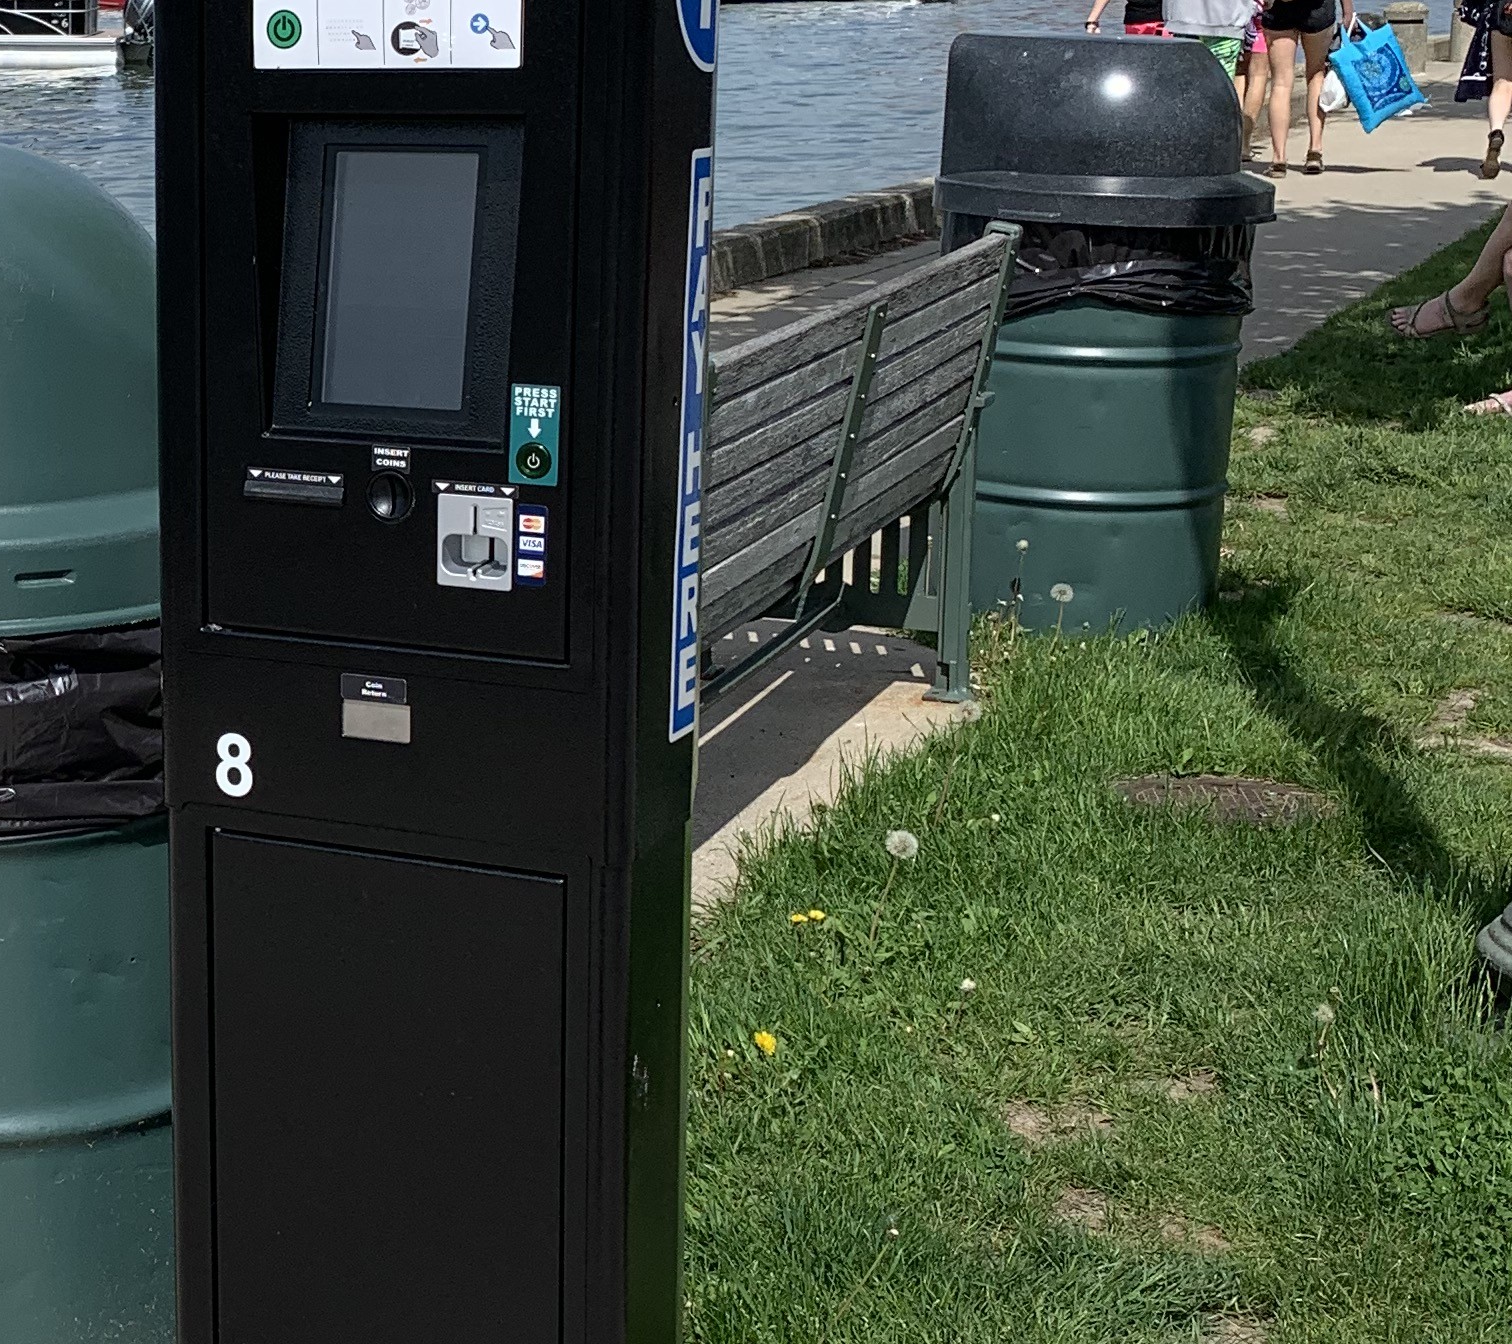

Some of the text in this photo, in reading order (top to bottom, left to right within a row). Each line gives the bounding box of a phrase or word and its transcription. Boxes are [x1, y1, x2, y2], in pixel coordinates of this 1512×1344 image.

[61, 17, 69, 28] 6
[514, 386, 558, 399] PRESS
[514, 396, 558, 408] START
[515, 406, 555, 418] FIRST
[373, 447, 410, 457] INSERT
[375, 457, 407, 468] COINS
[264, 471, 327, 483] PLEASE TAKE RECEIPT
[455, 483, 495, 494] INSERT CARD
[522, 539, 543, 549] VISA
[678, 430, 702, 711] HERE
[365, 681, 384, 690] Coin
[361, 688, 388, 698] Return
[215, 732, 254, 797] 8
